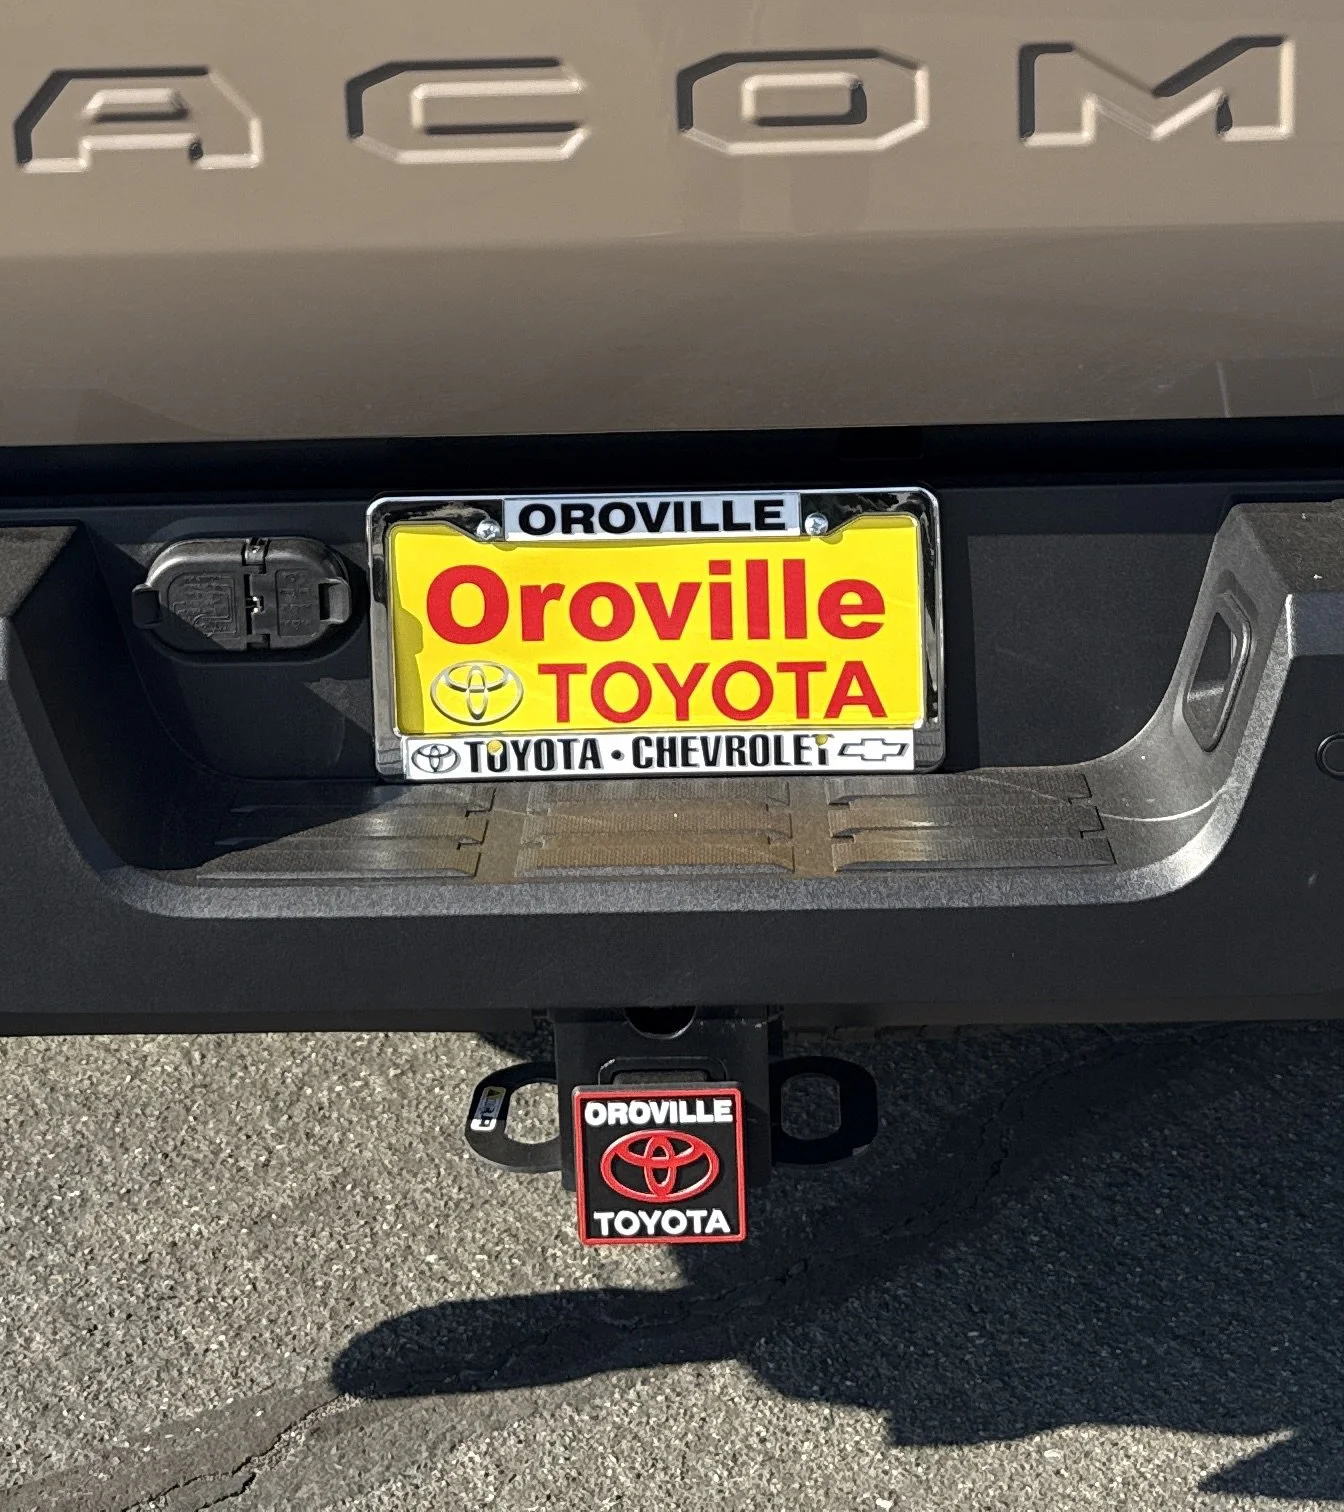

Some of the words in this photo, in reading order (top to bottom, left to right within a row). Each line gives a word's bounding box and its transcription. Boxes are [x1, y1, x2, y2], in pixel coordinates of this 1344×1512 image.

[517, 499, 787, 535] OROVILLE
[426, 559, 886, 644] Oroville
[537, 660, 887, 723] TOYOTA
[463, 738, 602, 773] TOYOTA
[632, 733, 832, 768] CHEVROLET
[584, 1100, 734, 1126] OROVILLE
[593, 1208, 731, 1236] TOYOTA
